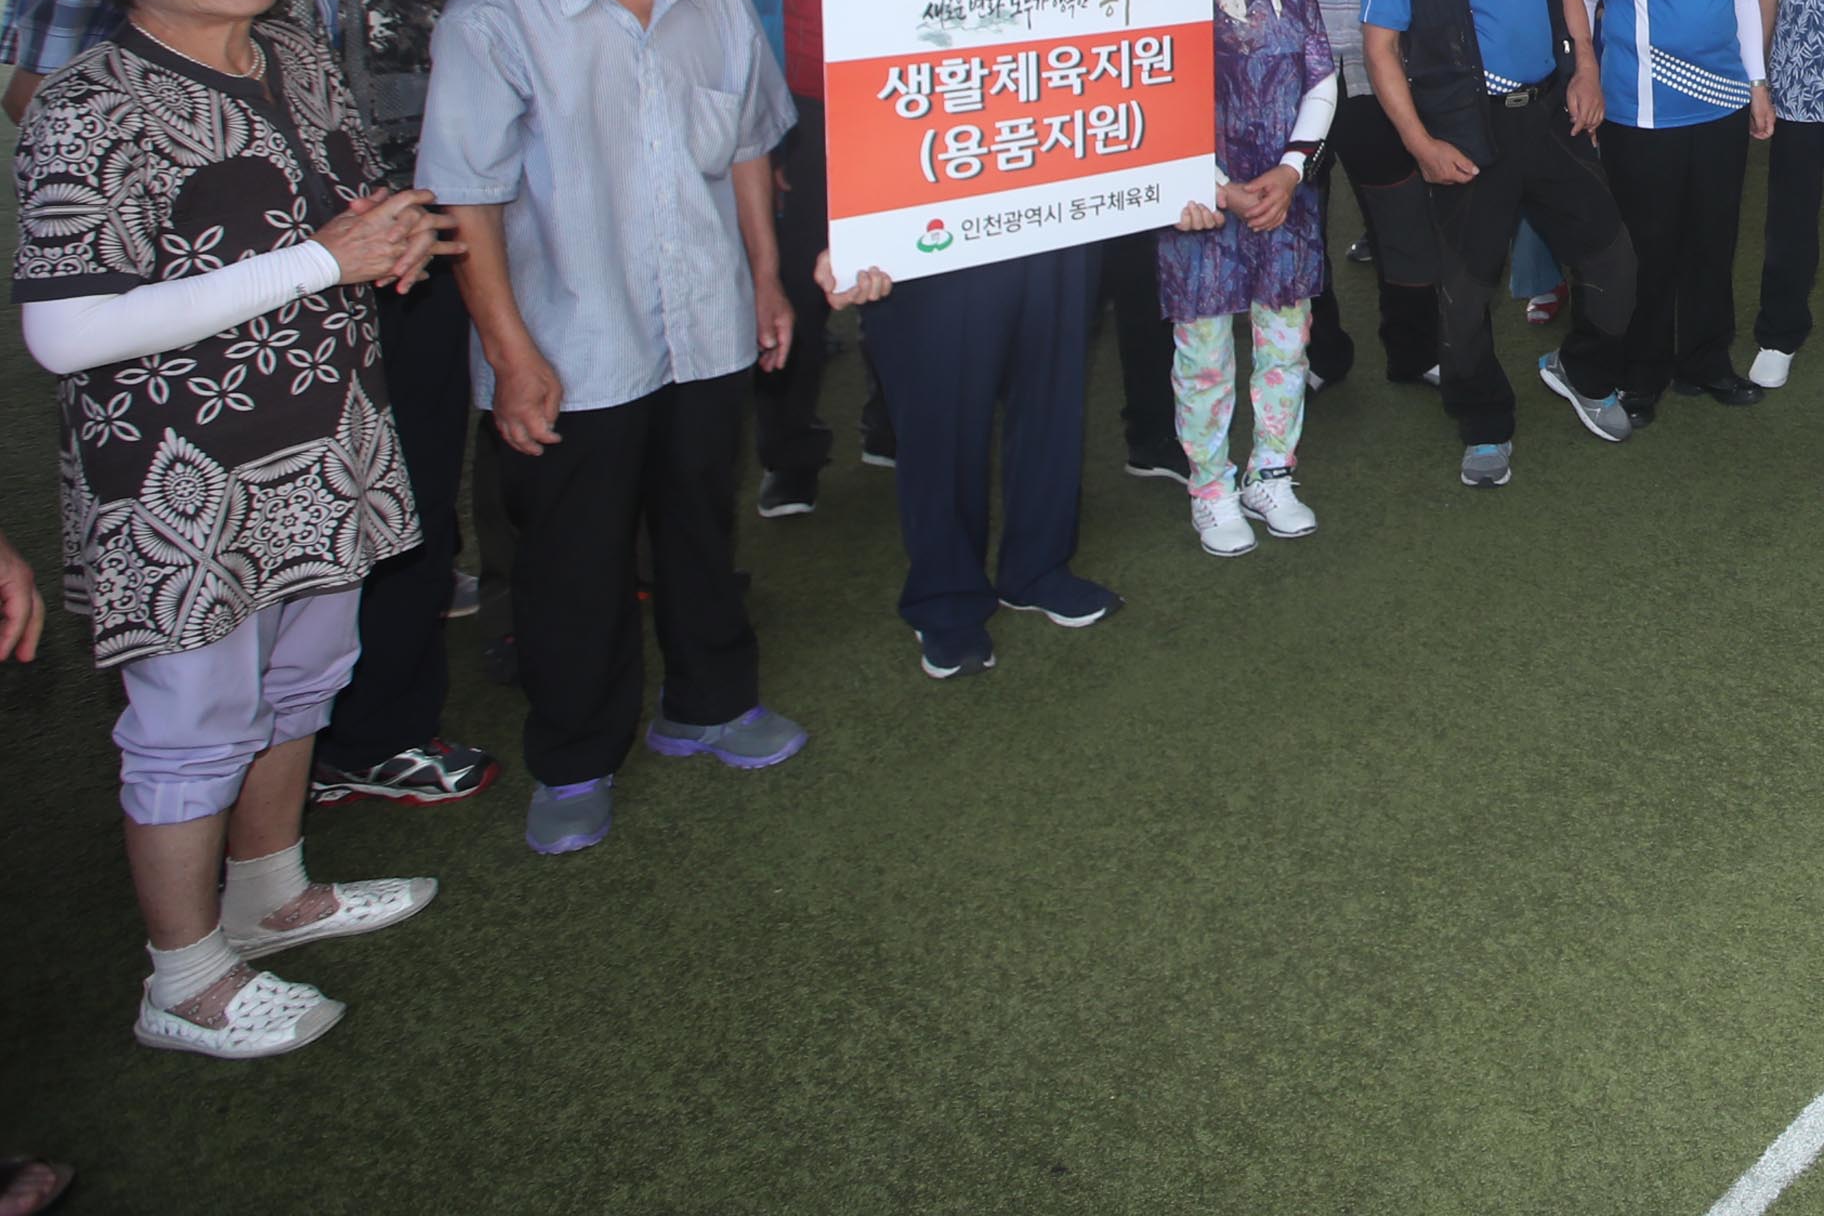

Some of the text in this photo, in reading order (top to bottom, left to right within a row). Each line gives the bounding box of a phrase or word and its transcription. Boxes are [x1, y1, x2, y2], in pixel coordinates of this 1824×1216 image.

[876, 34, 1175, 119] 생활체육지원
[919, 99, 1146, 183] (용품지원)
[961, 183, 1161, 241] 인천광역시 동구체육회
